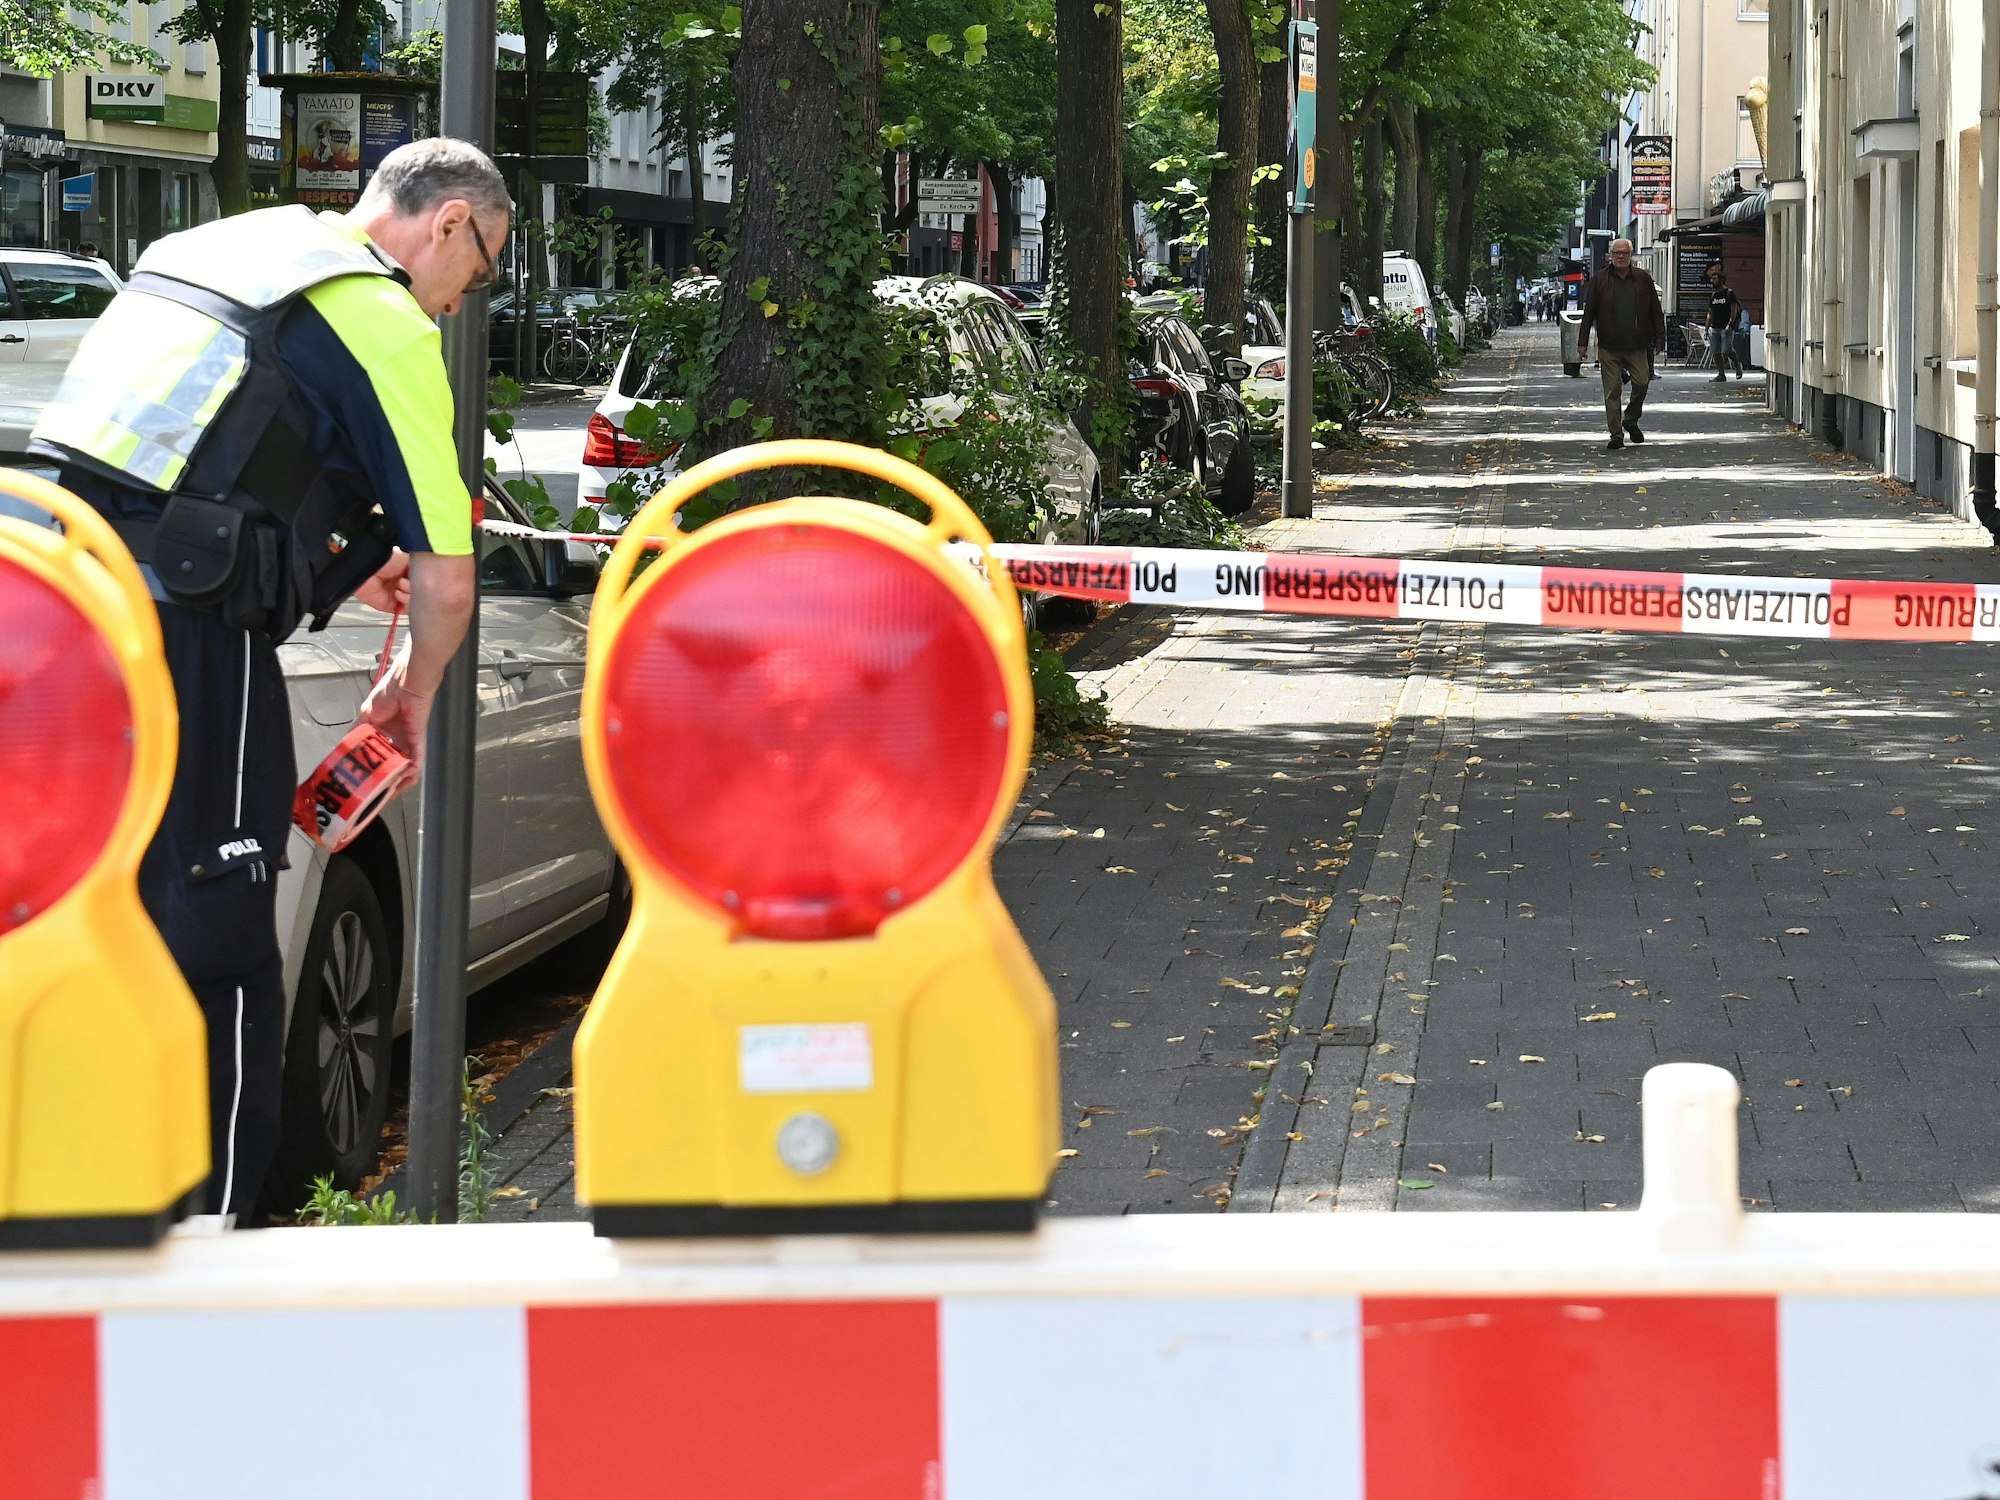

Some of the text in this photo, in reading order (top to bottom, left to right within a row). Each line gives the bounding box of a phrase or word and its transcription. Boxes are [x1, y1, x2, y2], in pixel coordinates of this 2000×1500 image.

[97, 82, 155, 97] DKV
[303, 97, 354, 110] YAMATO
[1216, 562, 1505, 610] POLIZEIABSPERRUNG
[1547, 579, 1851, 626] POLIZEIABSPERRUNG
[1894, 594, 2000, 628] RRUNG
